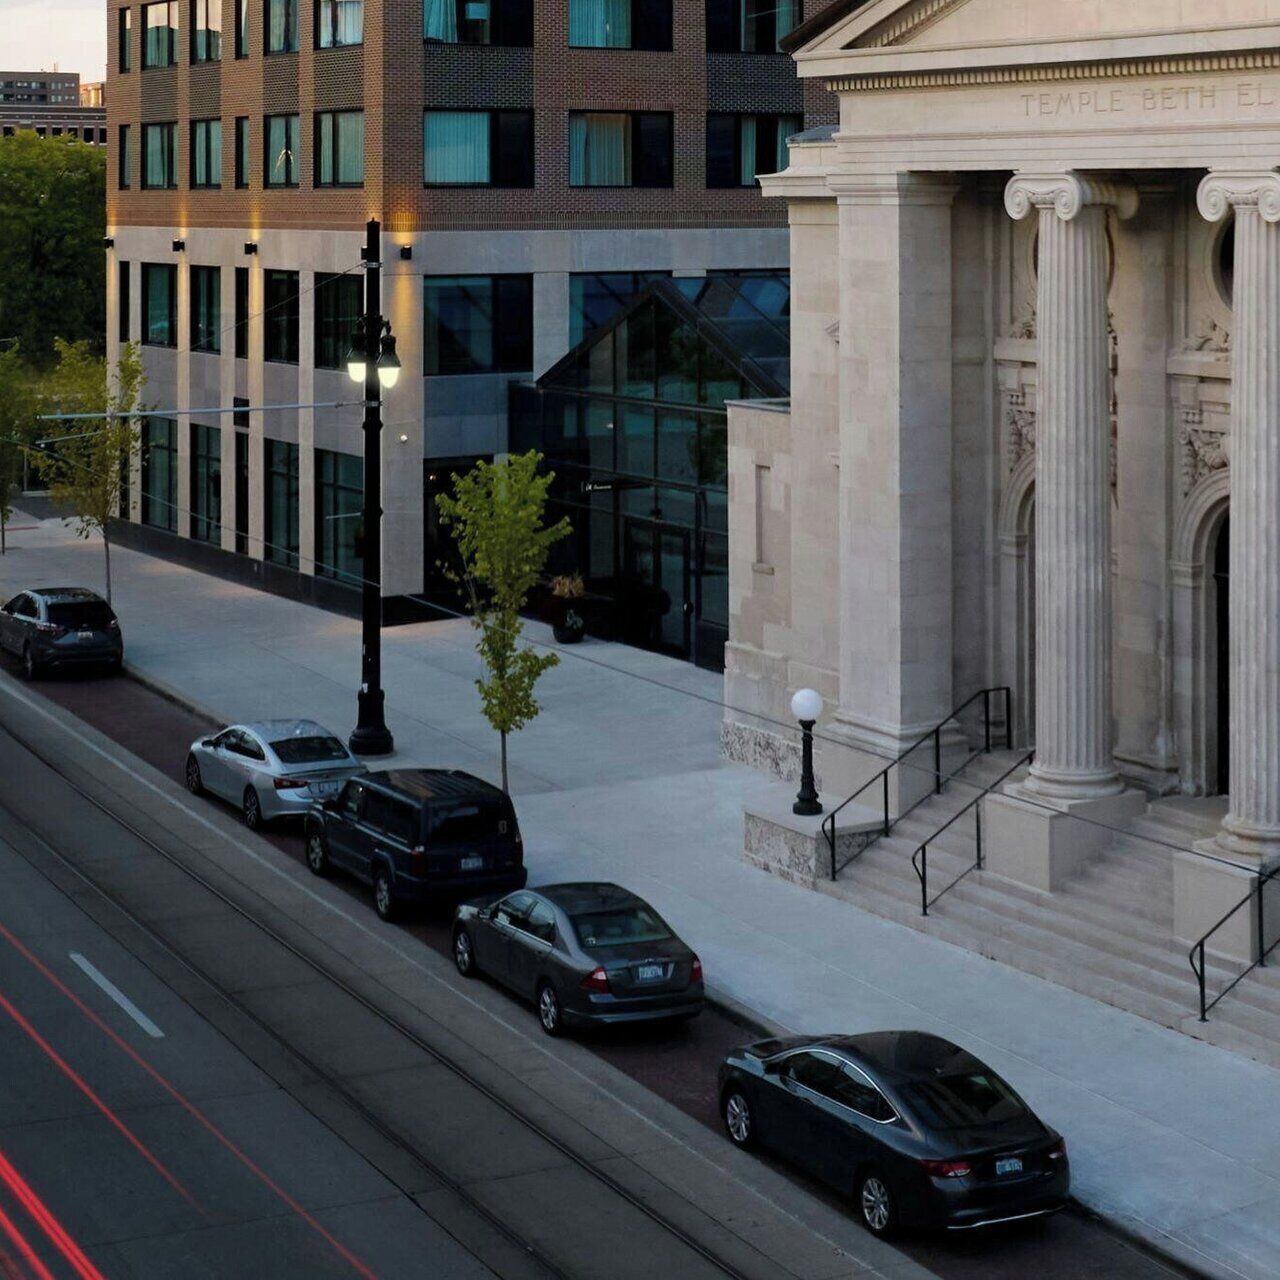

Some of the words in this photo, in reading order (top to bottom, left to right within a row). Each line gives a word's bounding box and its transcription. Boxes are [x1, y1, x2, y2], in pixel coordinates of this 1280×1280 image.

[1021, 90, 1124, 116] TEMPLE
[1142, 84, 1216, 111] BETH
[1236, 82, 1274, 107] EL
